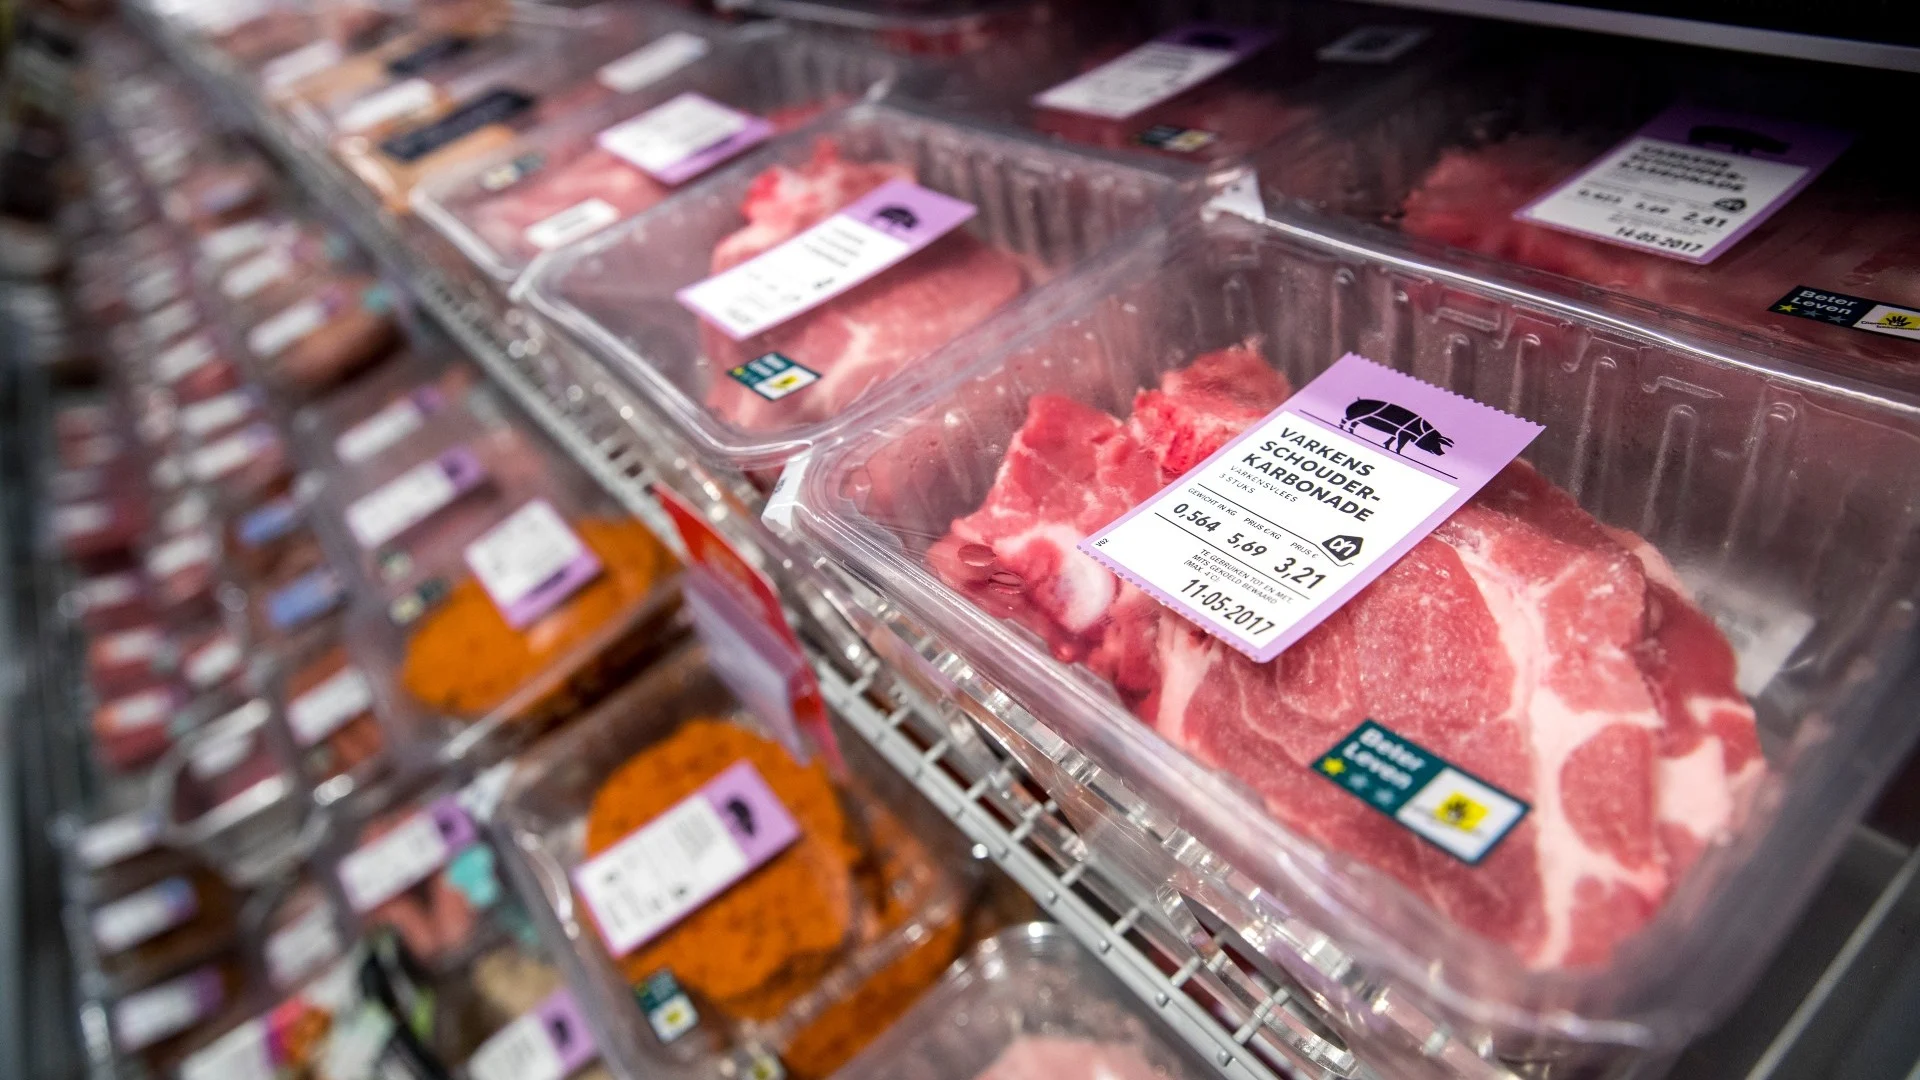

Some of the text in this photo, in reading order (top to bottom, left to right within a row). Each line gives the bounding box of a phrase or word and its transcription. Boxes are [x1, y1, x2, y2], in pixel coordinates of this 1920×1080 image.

[1790, 297, 1852, 315] Leven
[1799, 290, 1858, 307] Beter
[1259, 440, 1381, 502] SCHOUDER-
[1280, 427, 1375, 477] VARKENS
[1226, 476, 1256, 494] STUKS
[1230, 465, 1299, 503] VARKENSVLEES
[1242, 453, 1374, 522] KARBONADE
[1173, 503, 1327, 589] 0,564 5,69 3,21
[1188, 487, 1219, 506] GEWICHT
[1217, 503, 1227, 511] IN
[1226, 508, 1238, 516] KG
[1243, 517, 1264, 531] PRIJS
[1290, 541, 1312, 555] PRIJS
[1192, 554, 1278, 604] MITS GEKOELD BEWAARD
[1200, 549, 1211, 557] TE
[1209, 554, 1250, 579] GEBRUIKEN
[1251, 577, 1265, 587] TOT
[1263, 584, 1276, 593] EN
[1181, 579, 1275, 635] 11-05-2017
[1342, 740, 1413, 790] Leven
[1359, 728, 1425, 771] Beter
